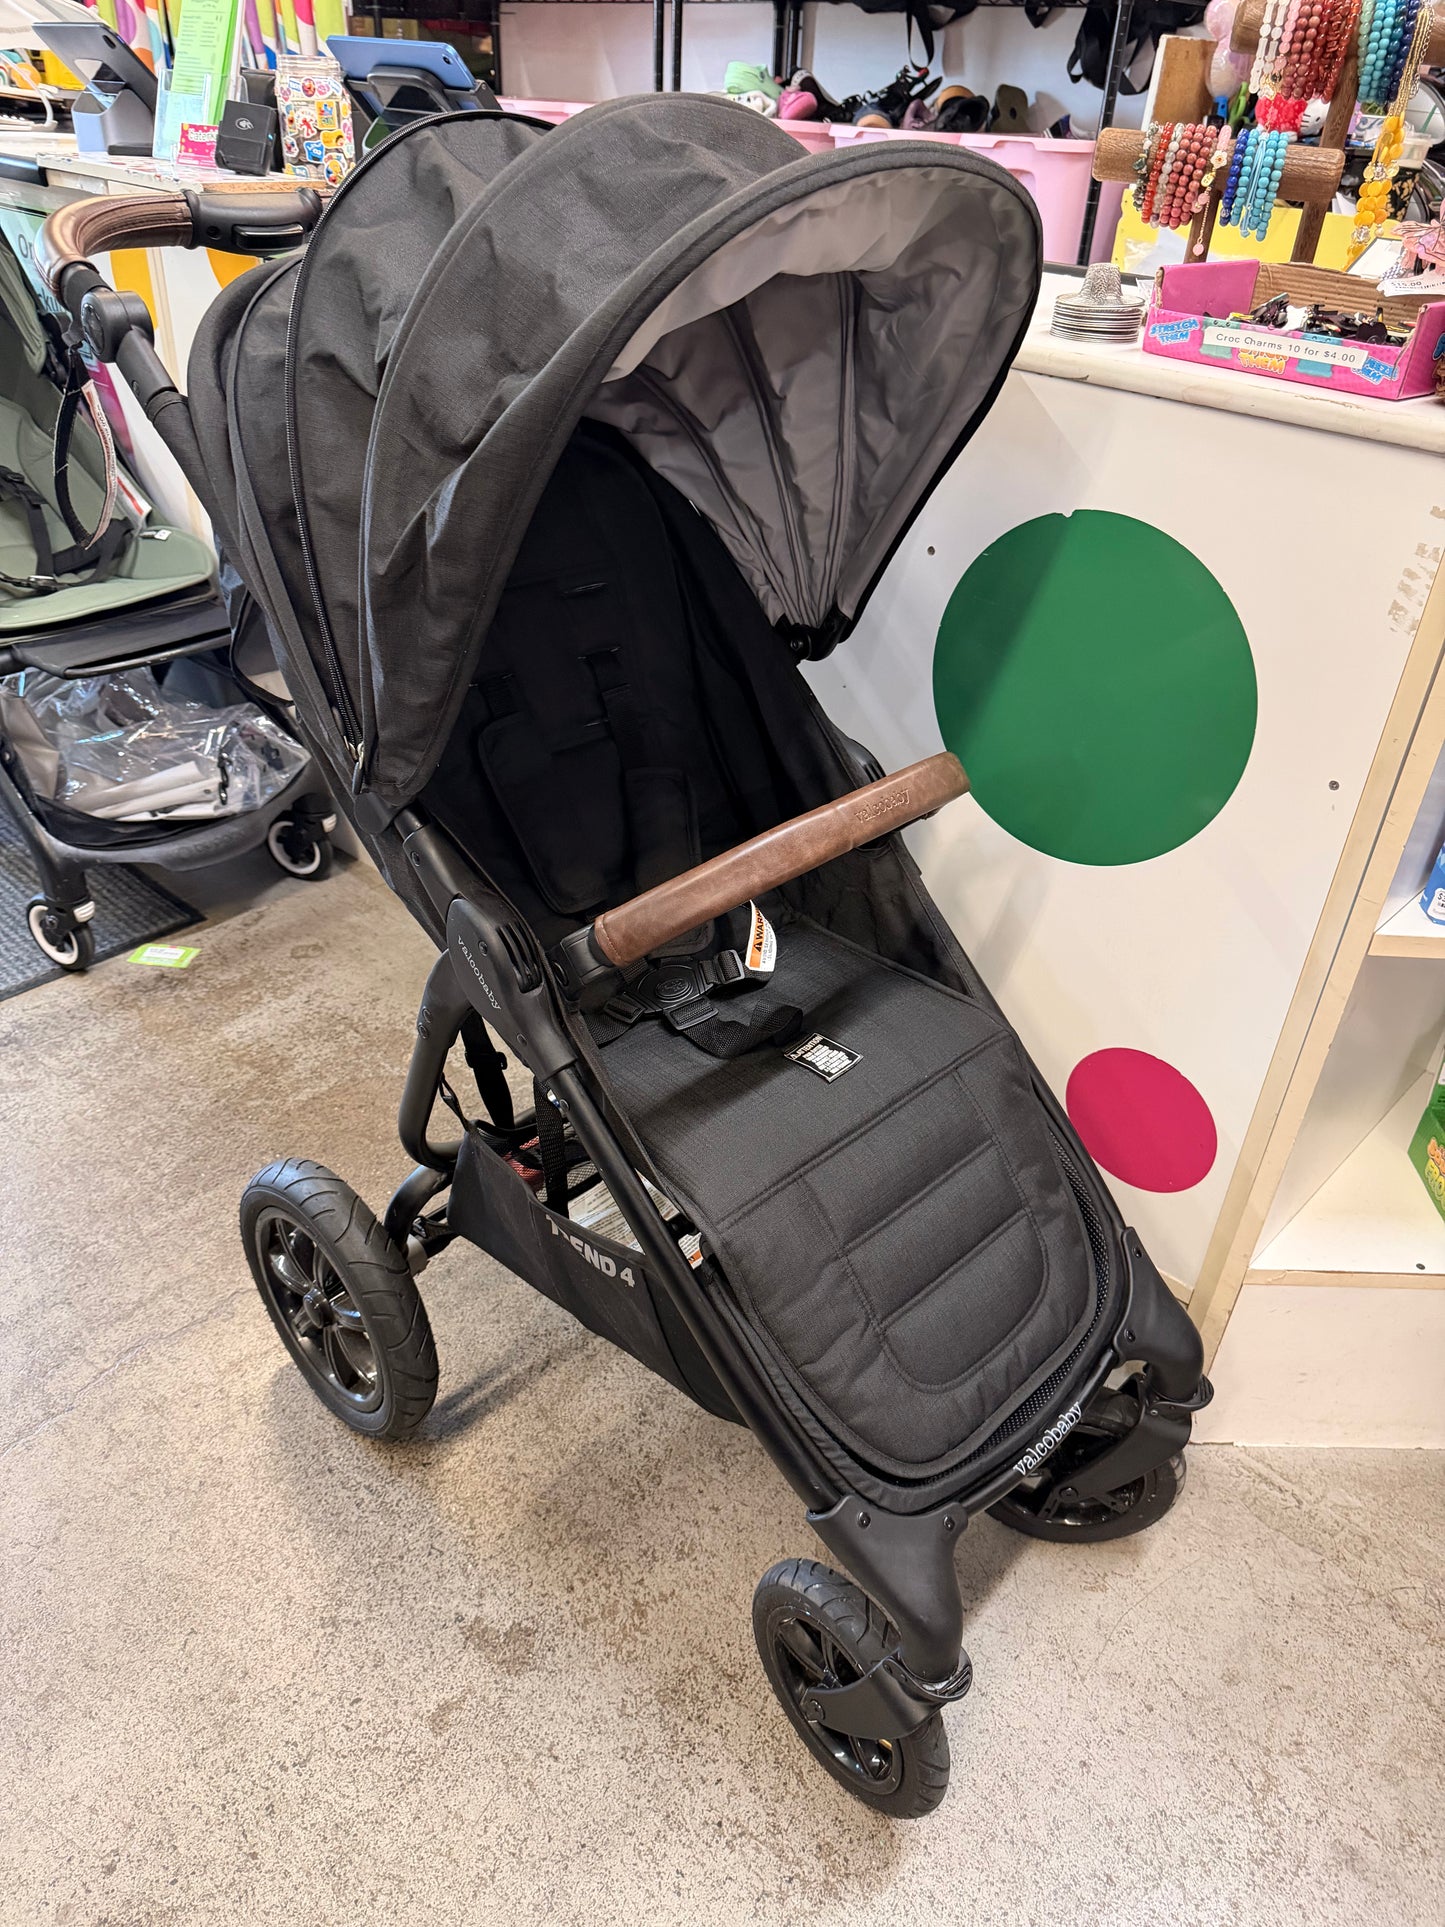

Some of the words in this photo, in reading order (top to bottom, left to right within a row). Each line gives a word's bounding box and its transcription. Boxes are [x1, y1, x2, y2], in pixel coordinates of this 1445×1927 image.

[1159, 331, 1189, 343] THEM
[1216, 333, 1240, 343] Croc
[1244, 336, 1283, 350] Charms
[1288, 344, 1301, 353] 10
[1304, 346, 1319, 356] for
[1323, 350, 1356, 363] $4.00
[1239, 353, 1286, 374] THEM
[457, 934, 502, 1010] valcobaby
[545, 1213, 617, 1278] TEND
[620, 1266, 636, 1288] 4
[1012, 1401, 1083, 1476] valcobaby
